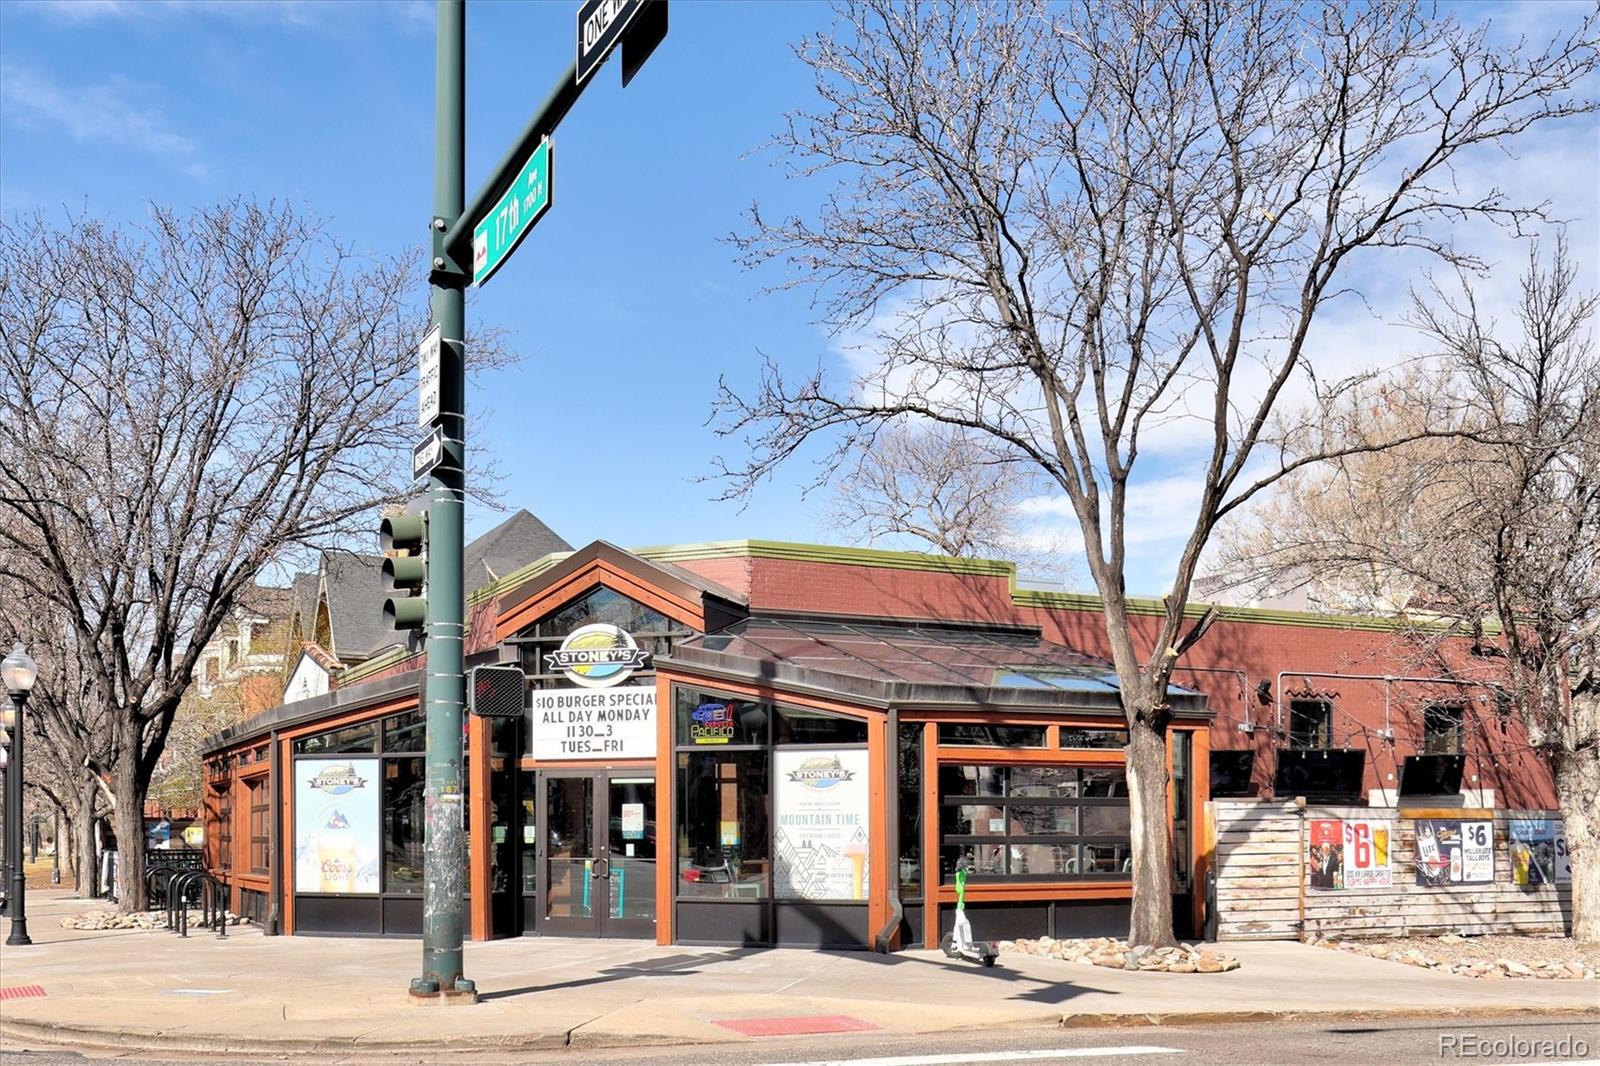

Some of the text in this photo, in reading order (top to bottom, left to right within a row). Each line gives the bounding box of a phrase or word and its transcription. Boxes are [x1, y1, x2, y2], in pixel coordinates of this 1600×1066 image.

[587, 0, 609, 47] ONE
[495, 194, 519, 252] 17th
[421, 391, 437, 414] AHEAD
[559, 649, 632, 663] STONEY'S
[536, 697, 554, 709] $10
[557, 694, 606, 708] BURGER
[542, 708, 650, 724] ALL DAY MONDAY
[315, 777, 360, 786] STONEY'S
[796, 770, 849, 779] STONEY'S
[780, 814, 861, 826] MOUNTAIN TIME
[1468, 825, 1487, 846] $6
[321, 859, 352, 874] Coors
